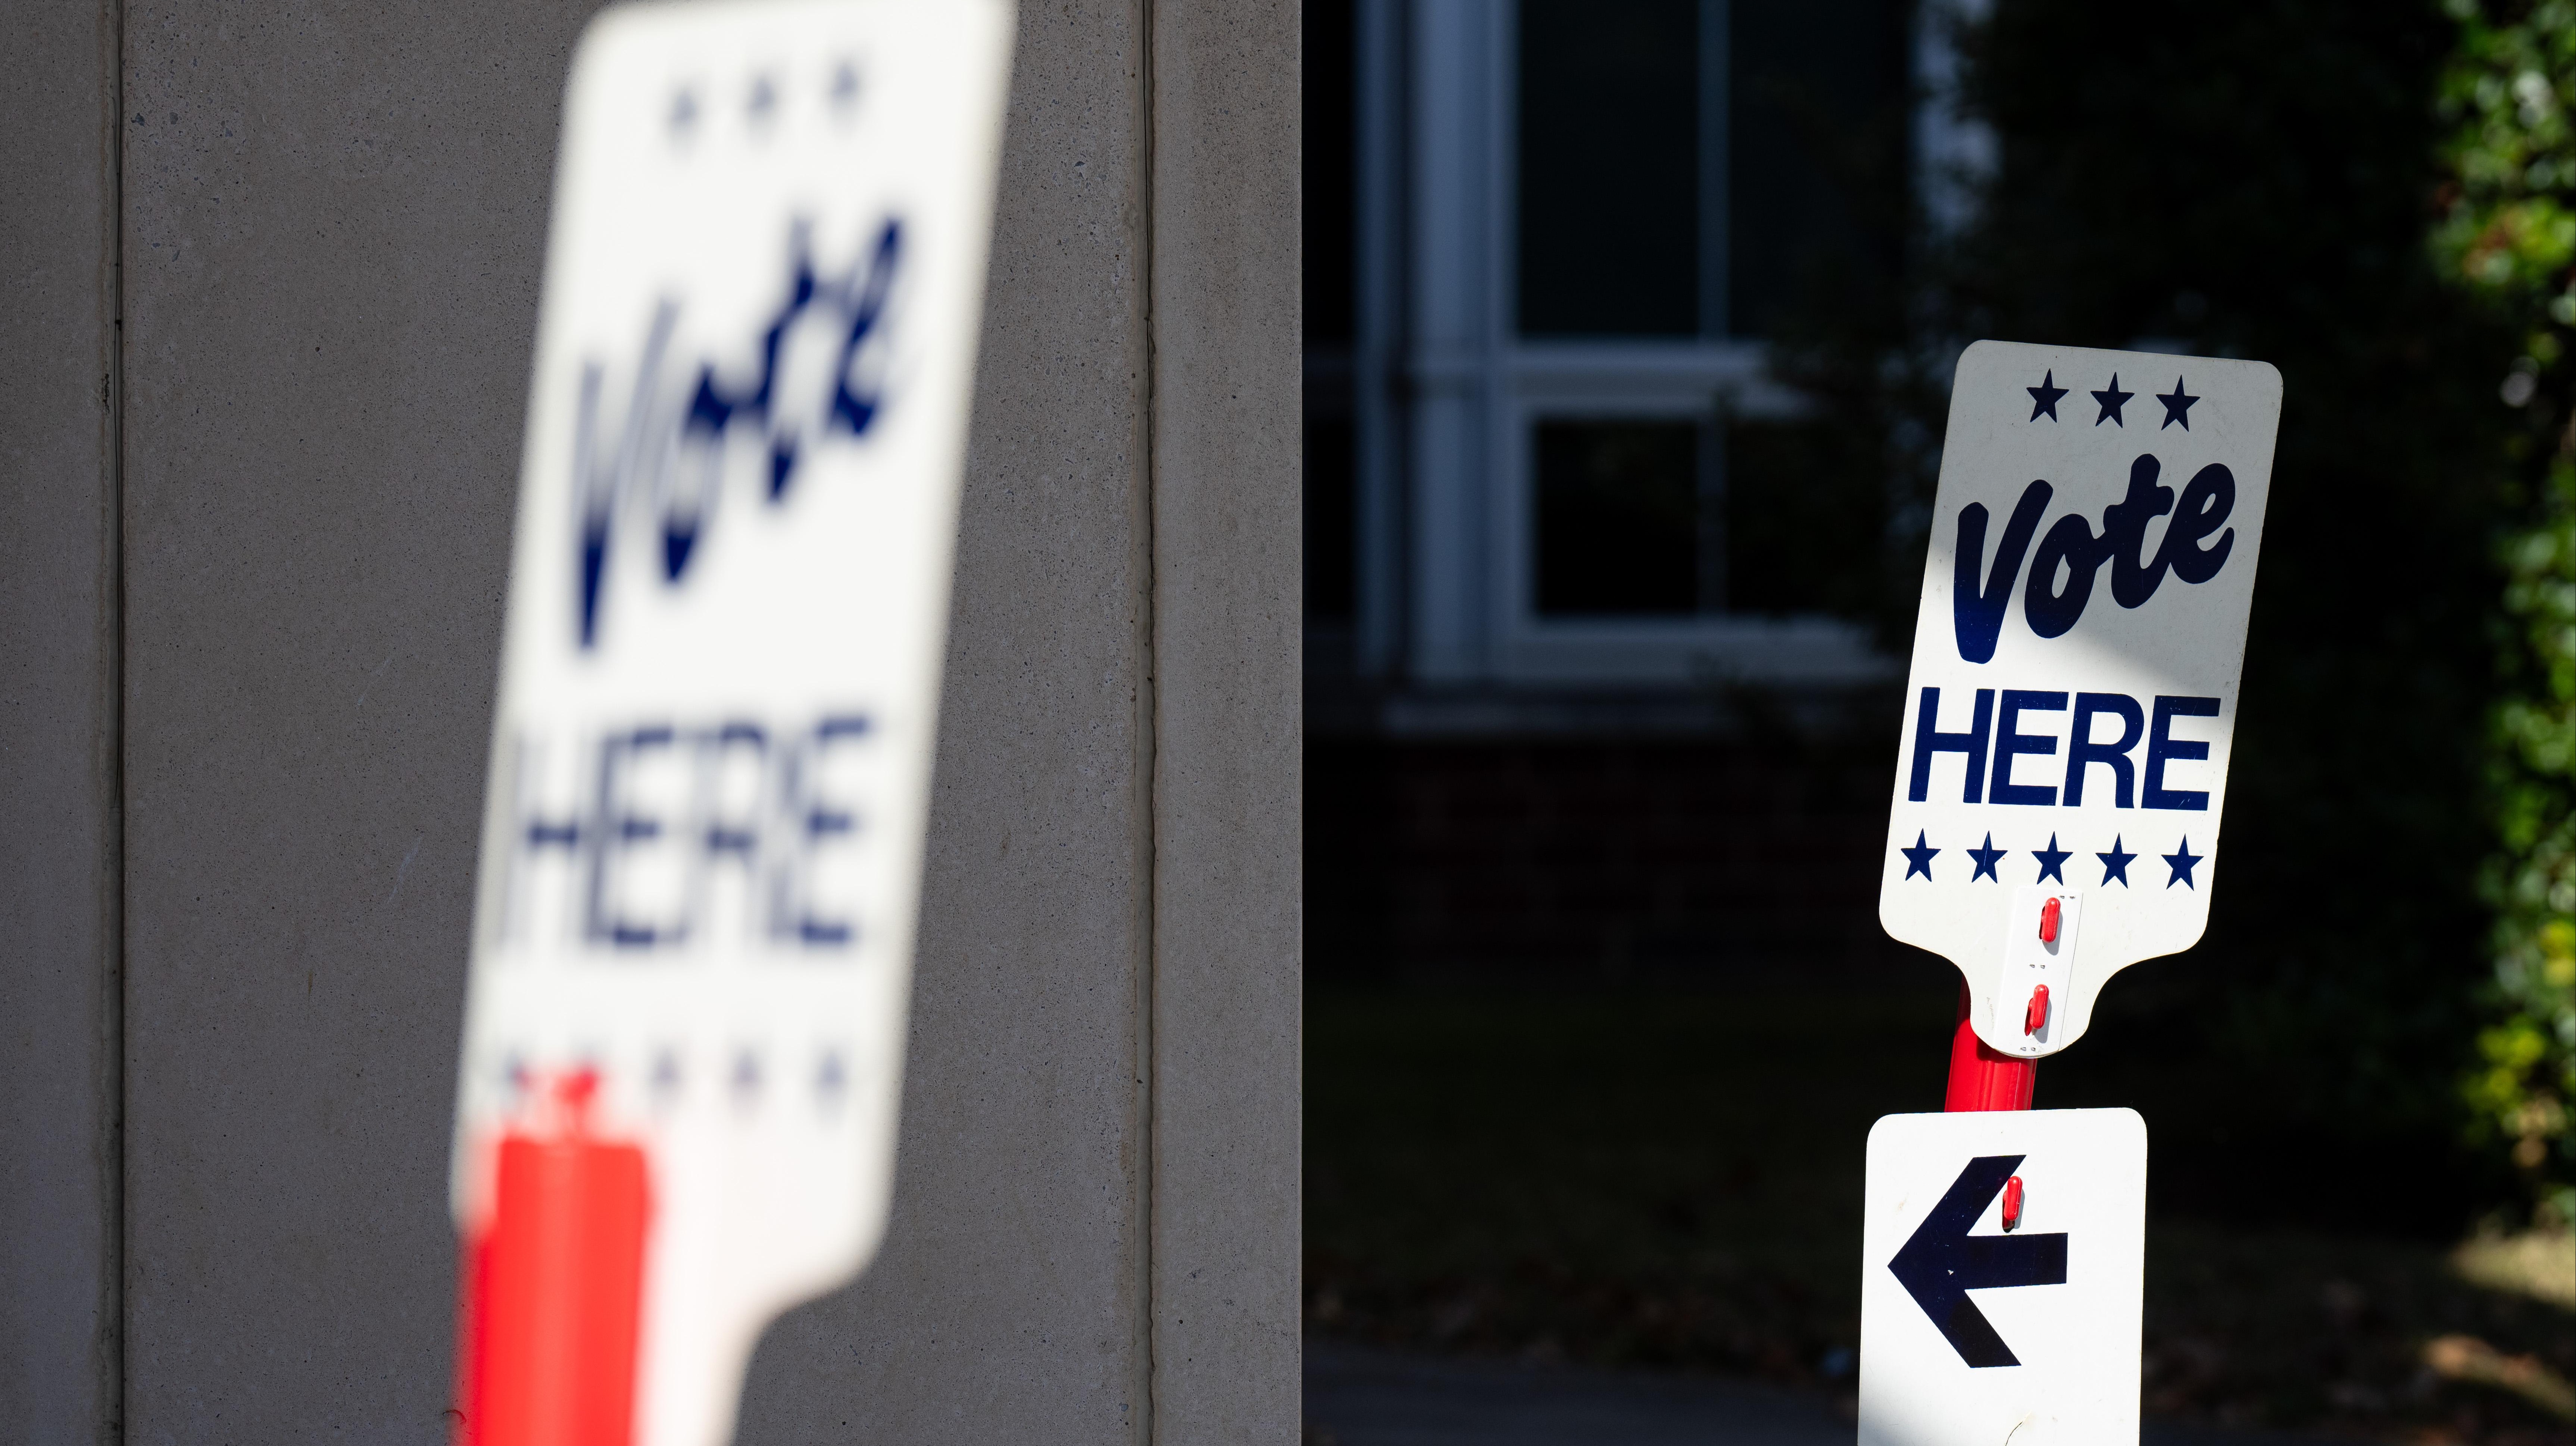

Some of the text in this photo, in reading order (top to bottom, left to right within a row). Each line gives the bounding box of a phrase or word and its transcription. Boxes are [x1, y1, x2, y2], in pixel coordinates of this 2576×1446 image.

[564, 209, 910, 657] Vote
[1954, 453, 2235, 664] Vote
[496, 711, 878, 955] HERE
[1908, 687, 2221, 811] HERE
